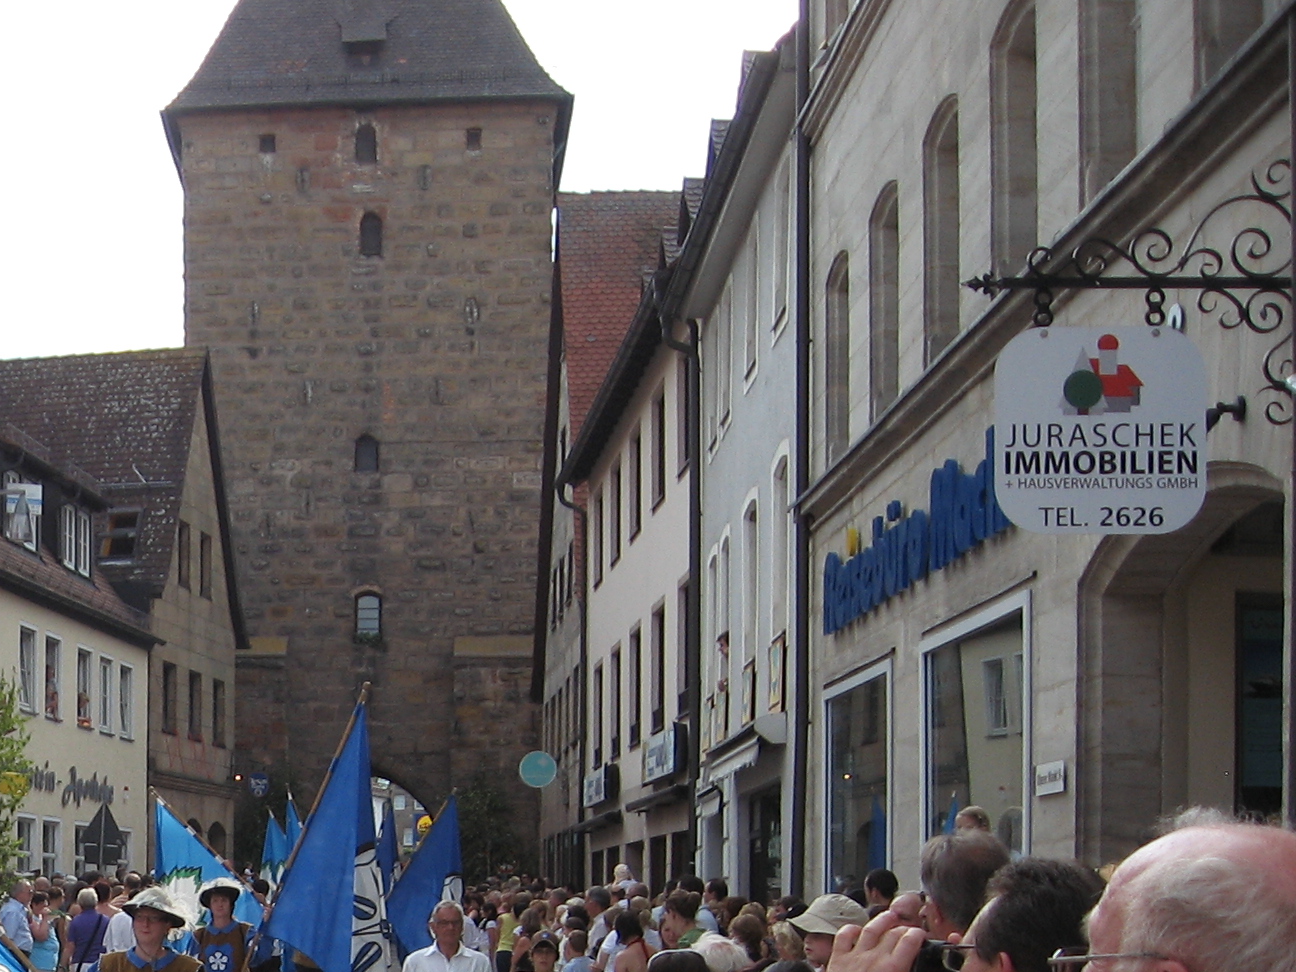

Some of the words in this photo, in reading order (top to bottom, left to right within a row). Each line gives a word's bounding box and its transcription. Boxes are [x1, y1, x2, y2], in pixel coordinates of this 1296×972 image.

[1004, 422, 1198, 448] JURASCHEK
[1004, 450, 1198, 475] IMMOBILIEN
[1017, 477, 1153, 489] HAUSVERWALTUNGS
[1156, 477, 1199, 489] GMBH
[1038, 506, 1089, 527] TEL.
[1099, 506, 1164, 527] 2626
